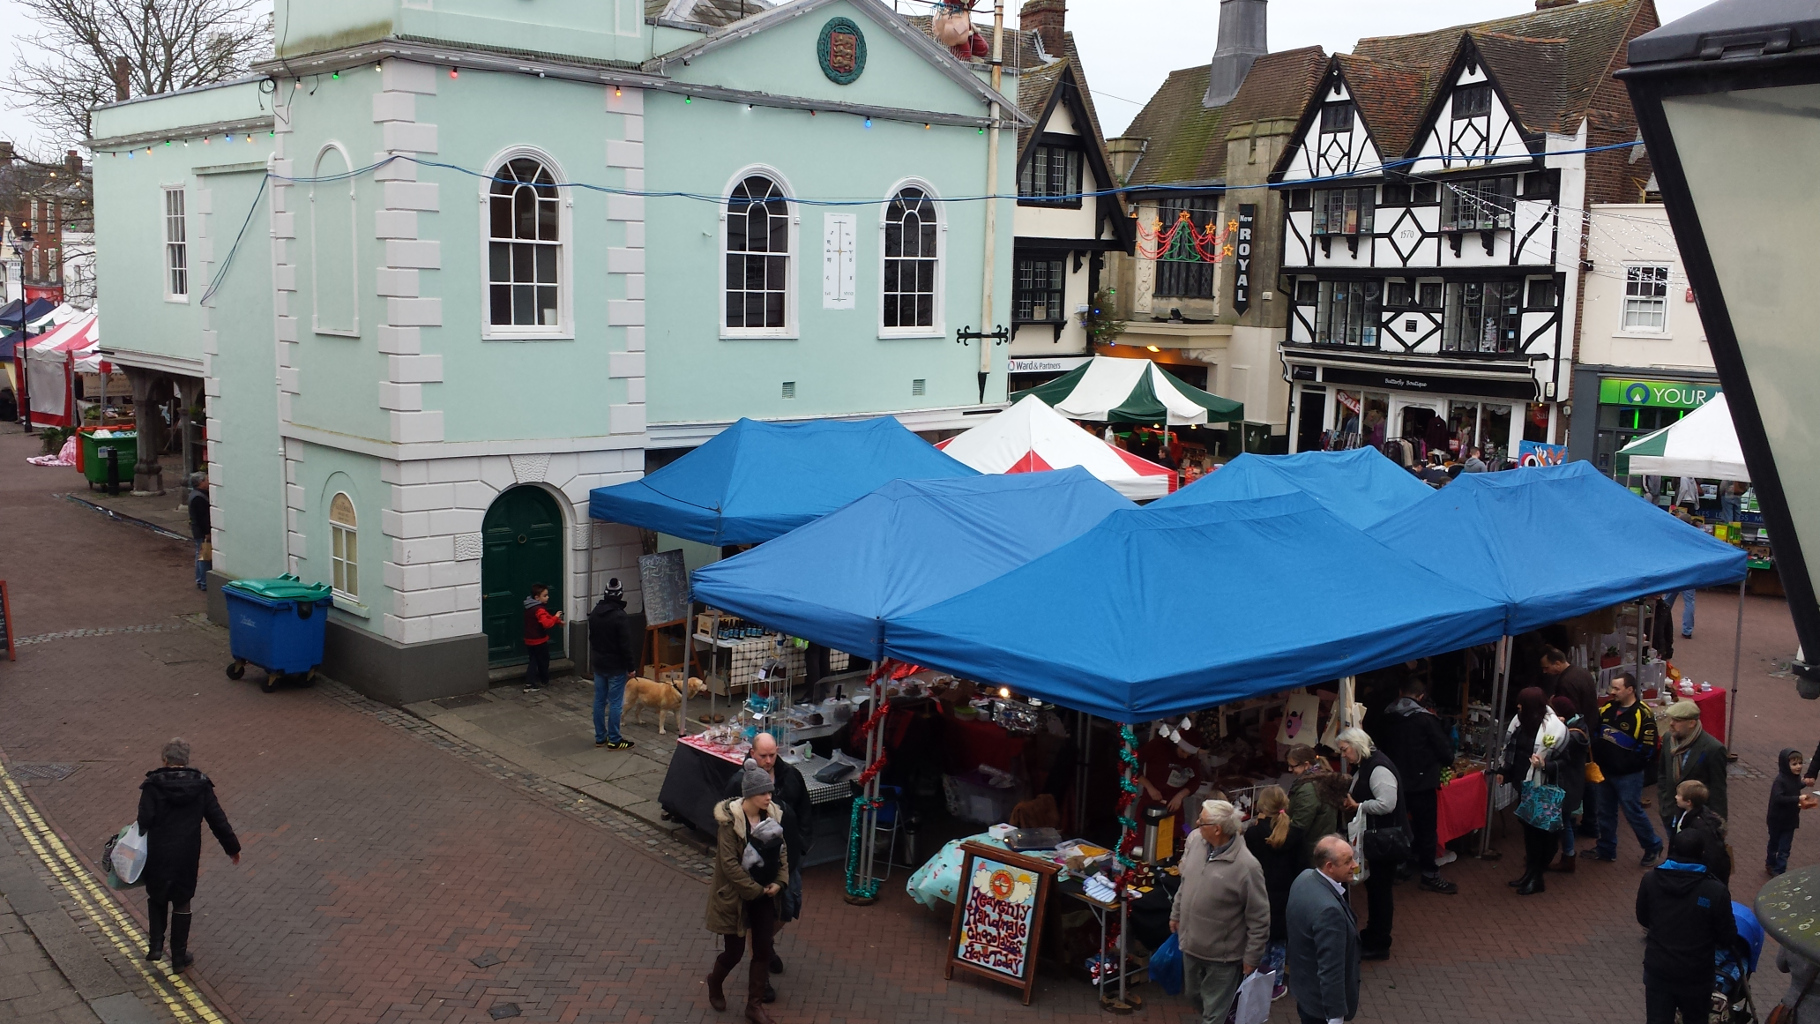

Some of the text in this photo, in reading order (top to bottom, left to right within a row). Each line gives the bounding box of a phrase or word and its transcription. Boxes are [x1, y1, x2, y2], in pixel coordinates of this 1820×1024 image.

[1239, 214, 1253, 222] New
[1400, 230, 1414, 239] 1570
[1237, 228, 1252, 302] ROYAL
[1016, 361, 1061, 371] Ward & Partners
[1406, 380, 1428, 389] Boutique
[1337, 392, 1360, 414] SALE
[1653, 387, 1707, 406] YOUR
[1536, 411, 1547, 420] Sal
[966, 886, 1032, 921] Heavenly
[964, 908, 1026, 940] Handmade
[962, 944, 1023, 975] Here Today
